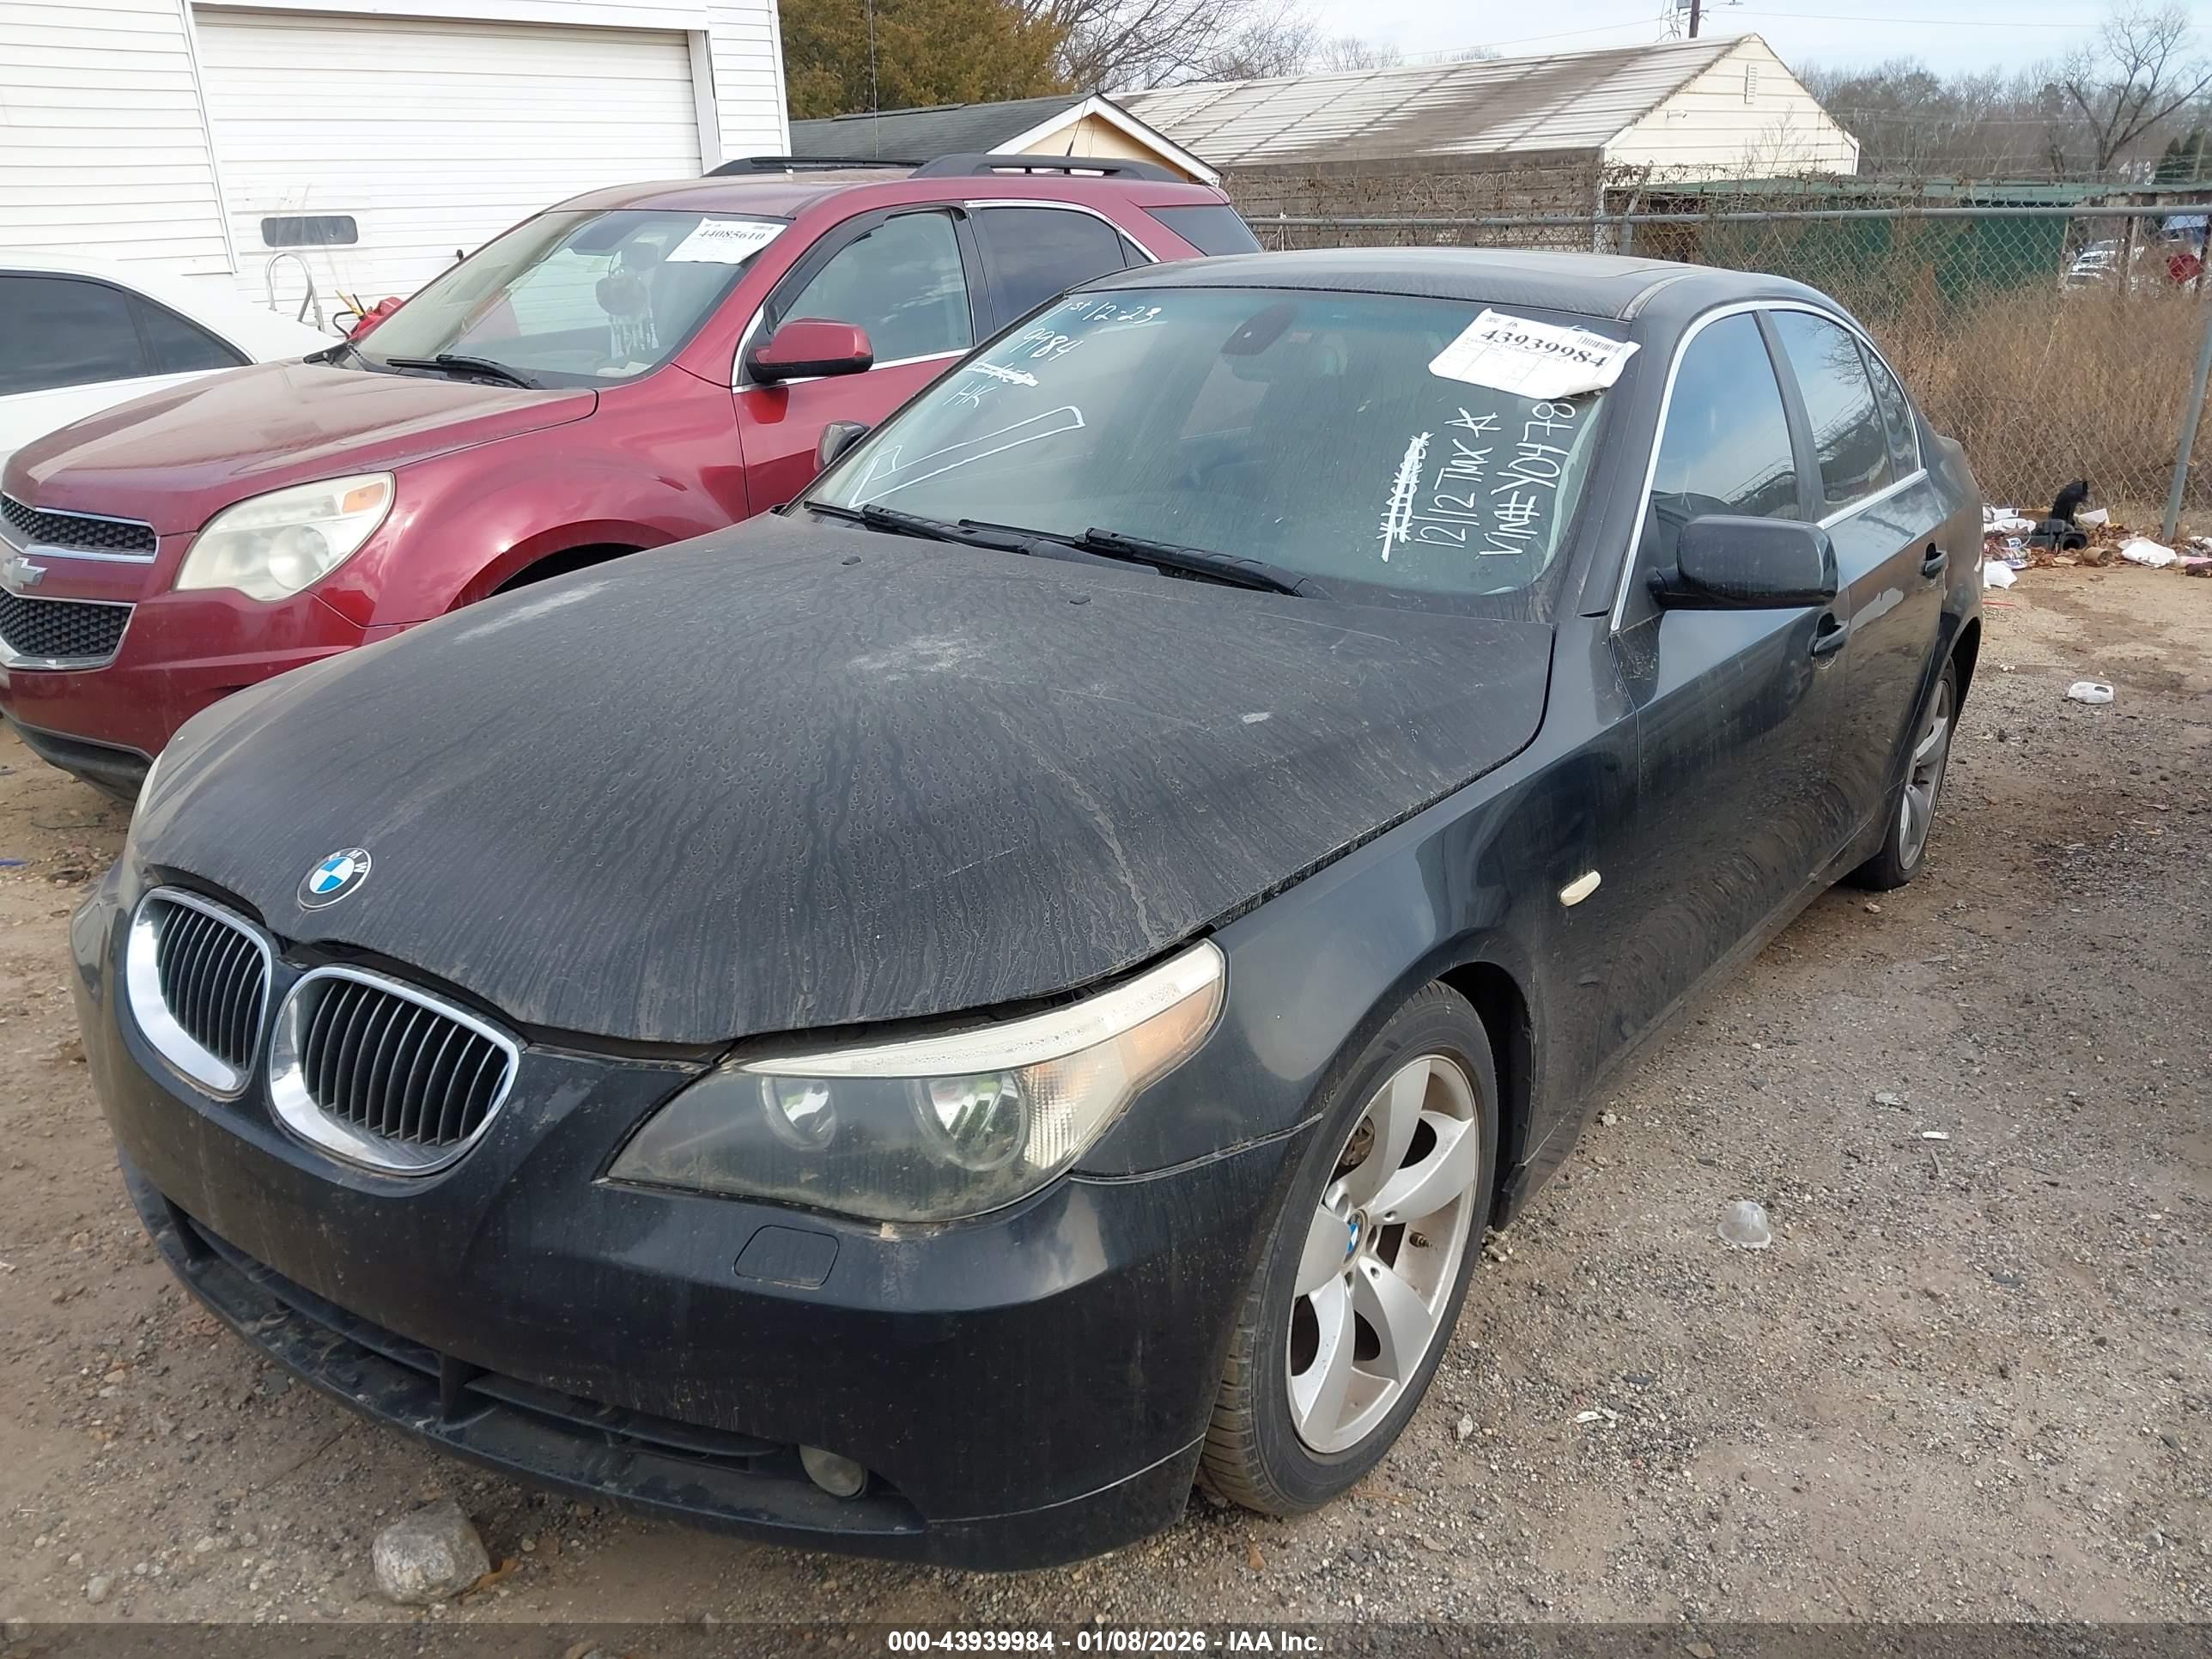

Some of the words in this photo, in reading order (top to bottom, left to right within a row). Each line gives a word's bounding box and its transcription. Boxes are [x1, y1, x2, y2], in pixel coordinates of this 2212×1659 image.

[699, 229, 766, 240] 44085610
[1010, 328, 1085, 362] 9984
[1480, 329, 1608, 368] 43939984
[942, 380, 997, 408] HK
[1434, 437, 1494, 490] TMX
[1412, 492, 1480, 549] 12/12
